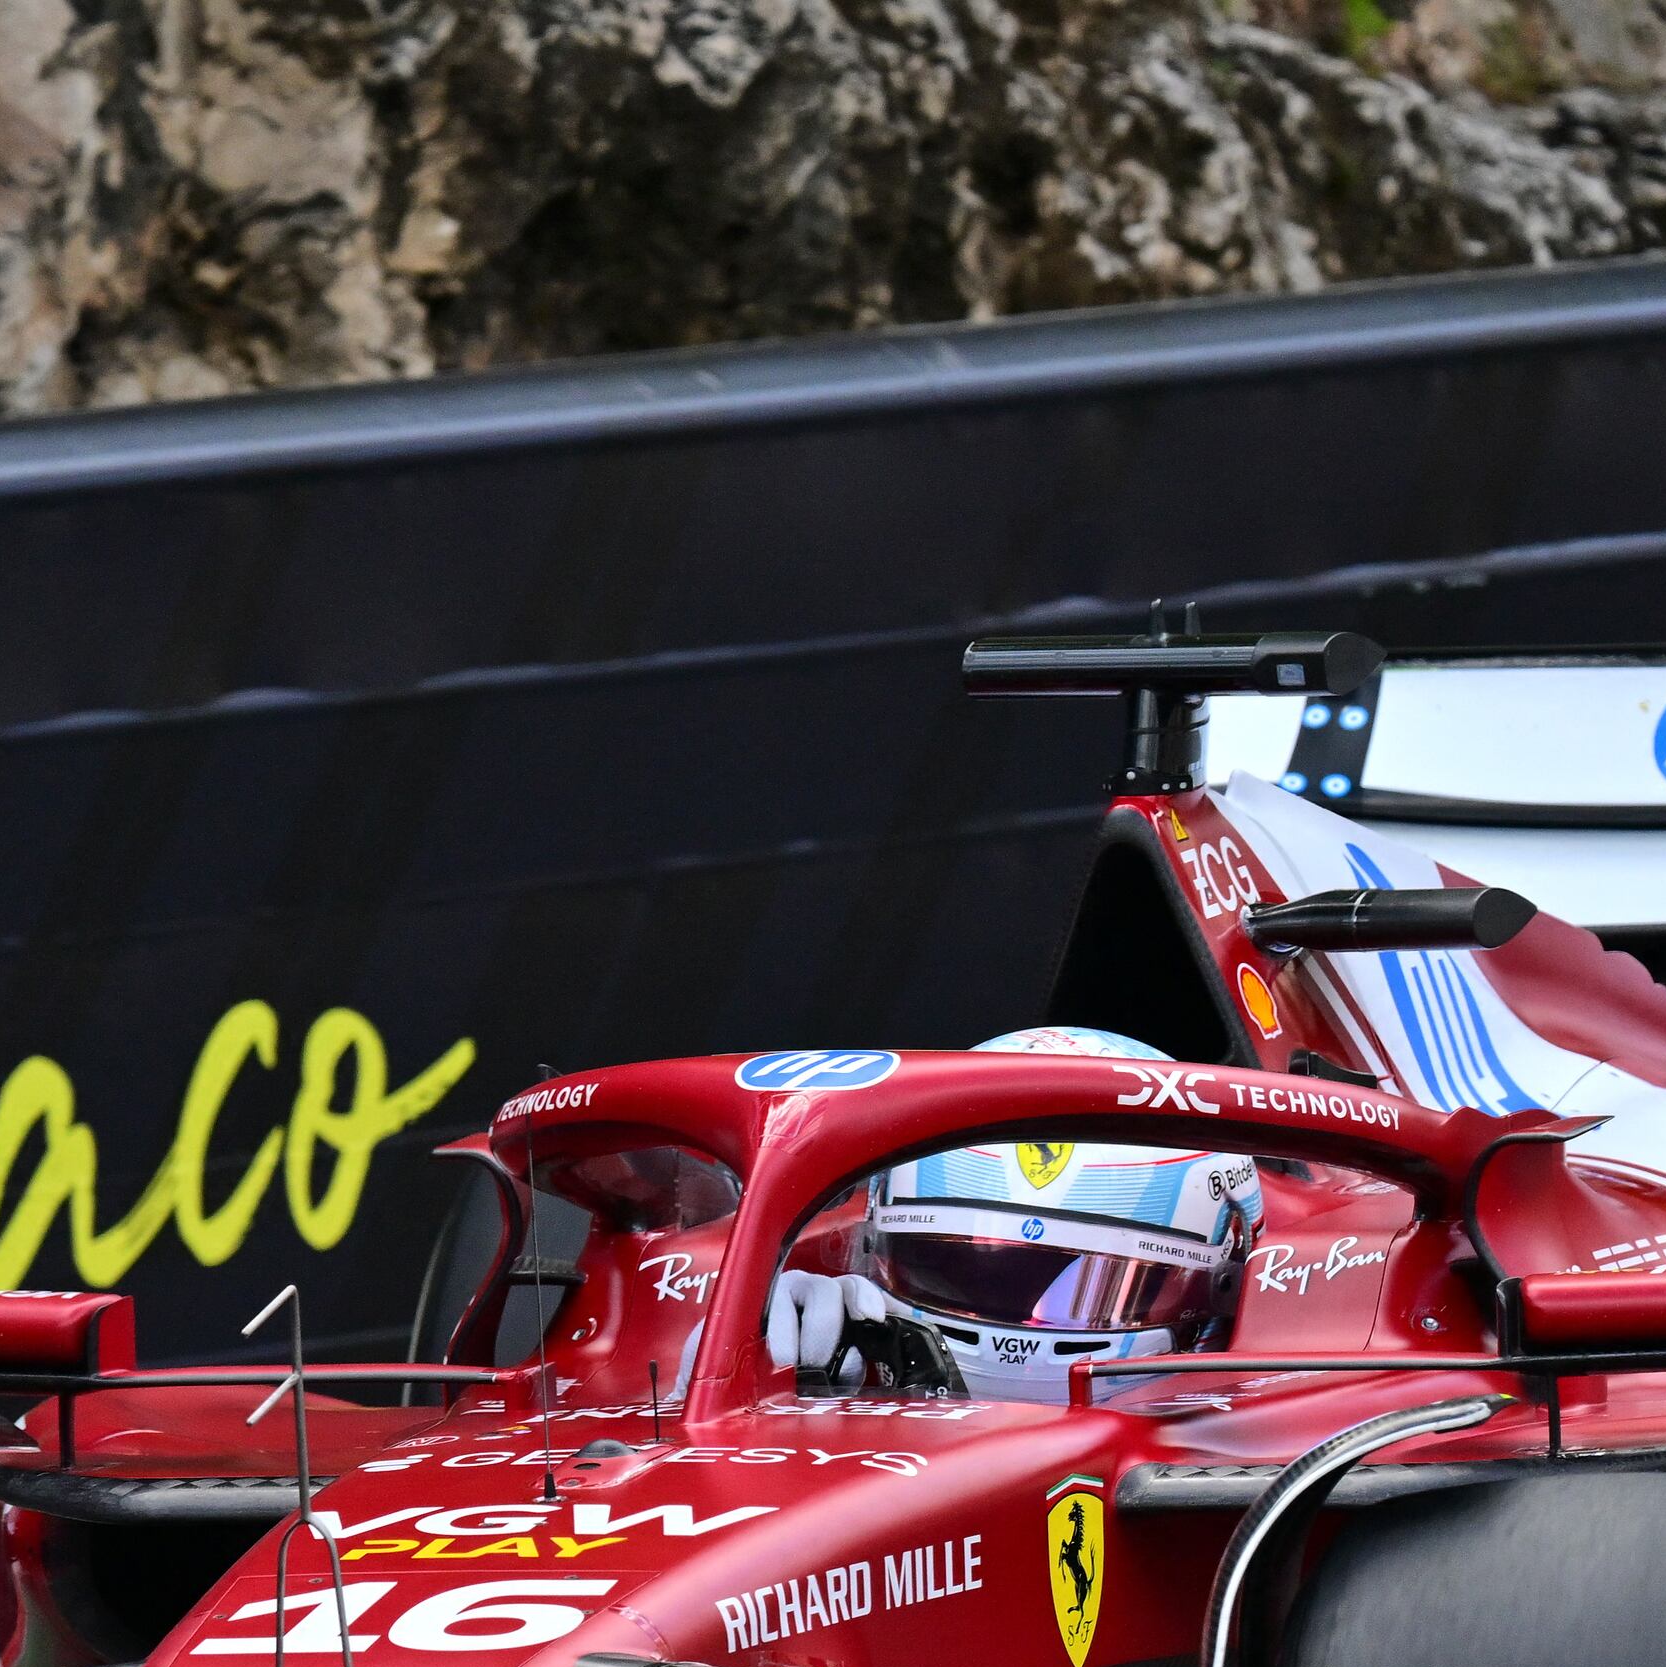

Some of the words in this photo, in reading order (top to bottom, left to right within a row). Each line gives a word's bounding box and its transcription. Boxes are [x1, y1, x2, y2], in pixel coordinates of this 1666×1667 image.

[748, 1050, 886, 1089] hp
[496, 1083, 600, 1123] TECHNOLOGY
[1112, 1065, 1221, 1115] DXC
[1229, 1083, 1400, 1130] TECHNOLOGY
[909, 1213, 936, 1224] MILLE
[1023, 1217, 1044, 1241] hp
[1138, 1240, 1185, 1259] RICHARD
[1186, 1250, 1213, 1264] MILLE
[992, 1335, 1042, 1355] VGW
[999, 1354, 1028, 1365] PLAY
[441, 1447, 928, 1478] GEESYS
[309, 1504, 780, 1540] VGW
[340, 1537, 629, 1561] PLAY
[715, 1560, 872, 1654] RICHARD
[884, 1534, 983, 1611] MILLE
[189, 1579, 620, 1656] 16
